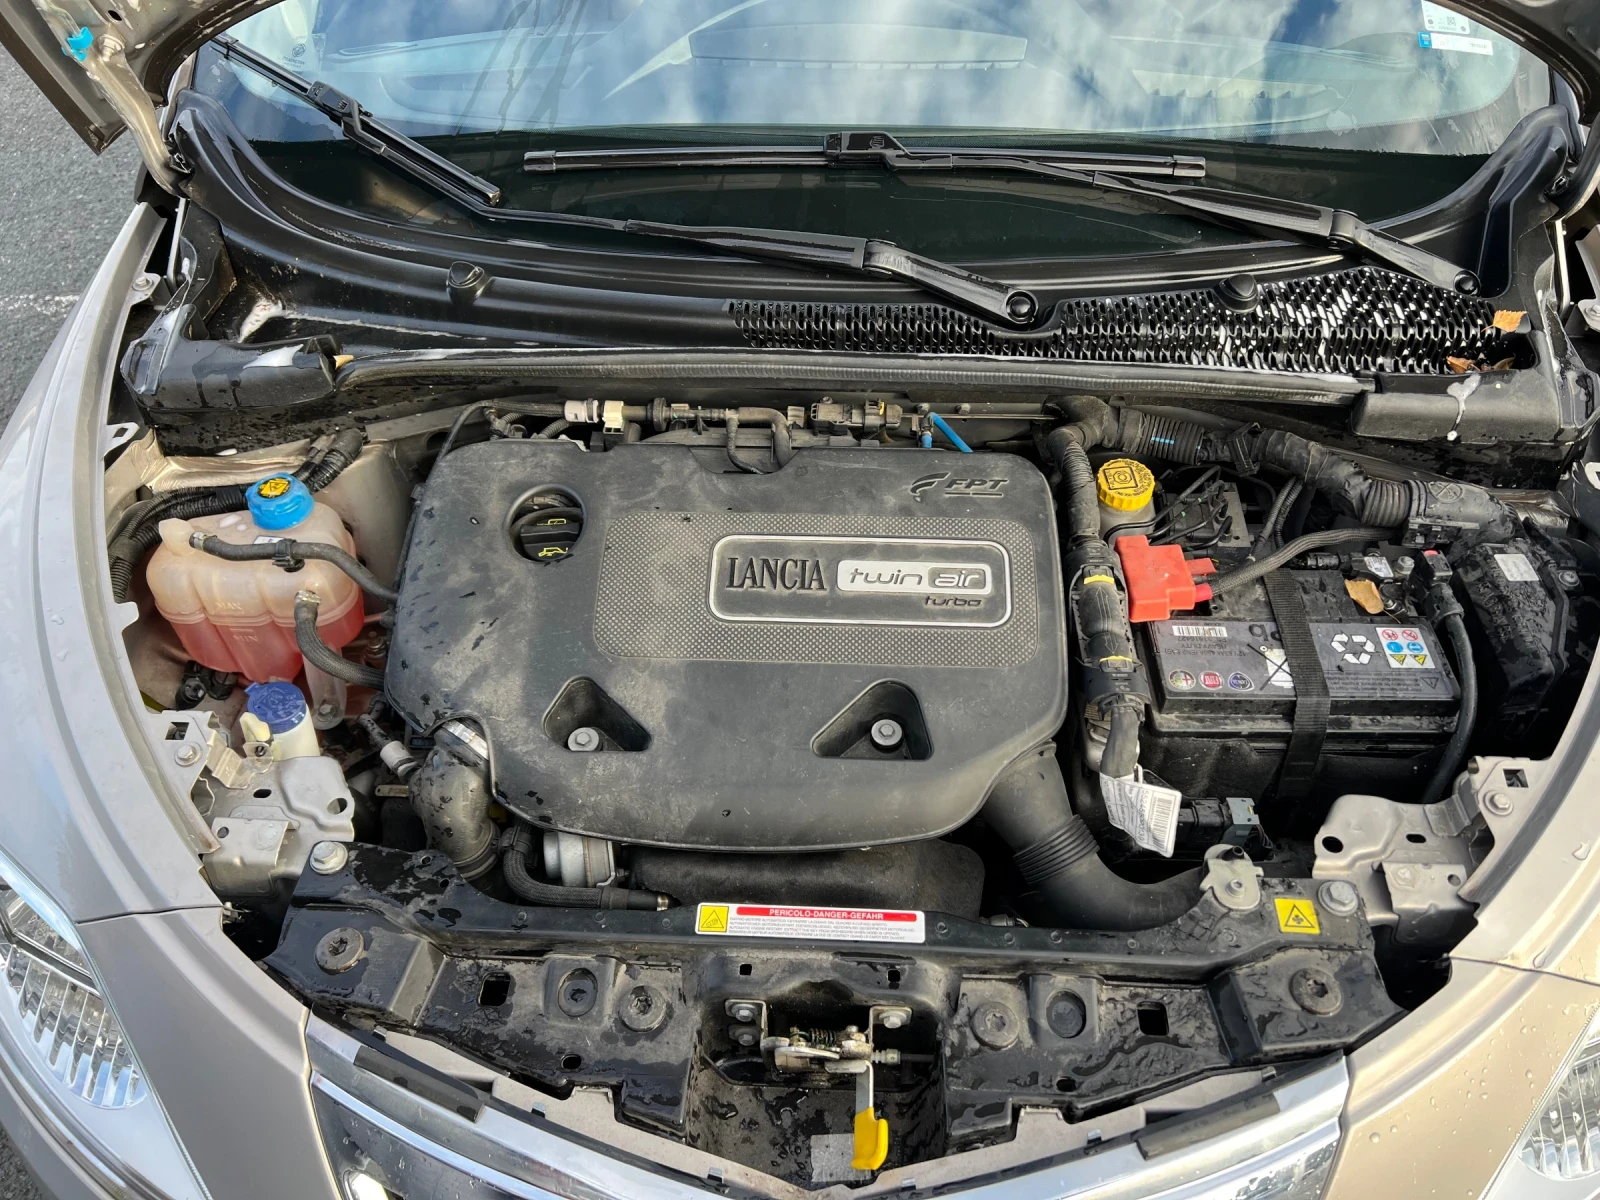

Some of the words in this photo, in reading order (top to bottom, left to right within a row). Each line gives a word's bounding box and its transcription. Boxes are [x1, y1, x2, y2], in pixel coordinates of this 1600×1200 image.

[944, 478, 1010, 491] FPT
[725, 556, 828, 592] LANCIA
[849, 566, 923, 587] twin
[933, 569, 981, 588] air
[923, 594, 983, 608] turbo
[1204, 675, 1220, 685] FIAT
[769, 908, 884, 920] PERICOLO-DANGER-GEFAHR
